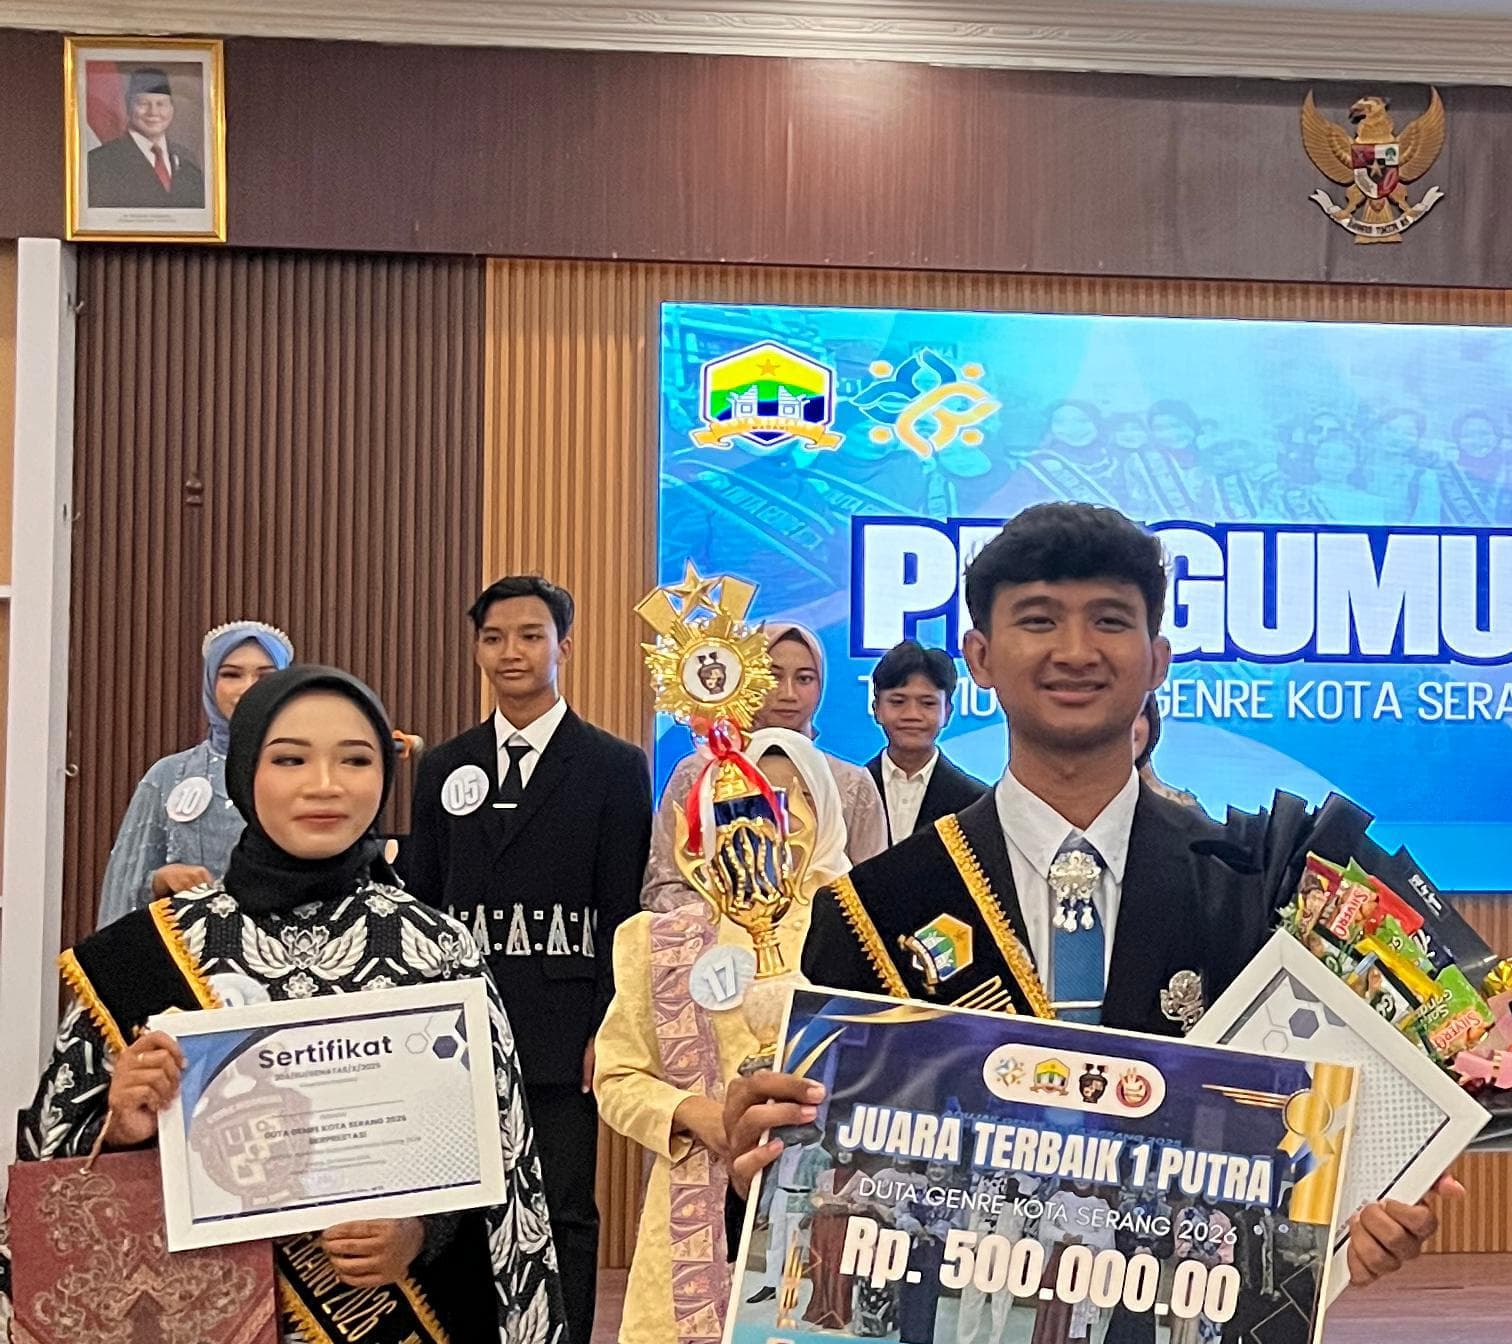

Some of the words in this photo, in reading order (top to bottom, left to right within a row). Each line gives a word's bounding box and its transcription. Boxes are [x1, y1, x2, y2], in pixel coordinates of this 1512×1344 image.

[1288, 680, 1403, 719] KOTA
[175, 786, 203, 814] 10
[449, 773, 480, 810] 05
[703, 956, 738, 1003] 17
[258, 1035, 394, 1069] Sertifikat
[838, 1105, 962, 1163] JUARA
[974, 1123, 1122, 1185] TERBAIK
[1130, 1144, 1153, 1187] 1
[1157, 1147, 1272, 1204] PUTRA
[860, 1177, 917, 1202] DUTA
[924, 1186, 1004, 1215] GENRE
[1013, 1199, 1069, 1223] KOTA
[1079, 1208, 1172, 1237] SERANG
[1179, 1222, 1238, 1246] 2026
[839, 1215, 922, 1289] Rp.
[939, 1229, 1241, 1323] 500.000.00
